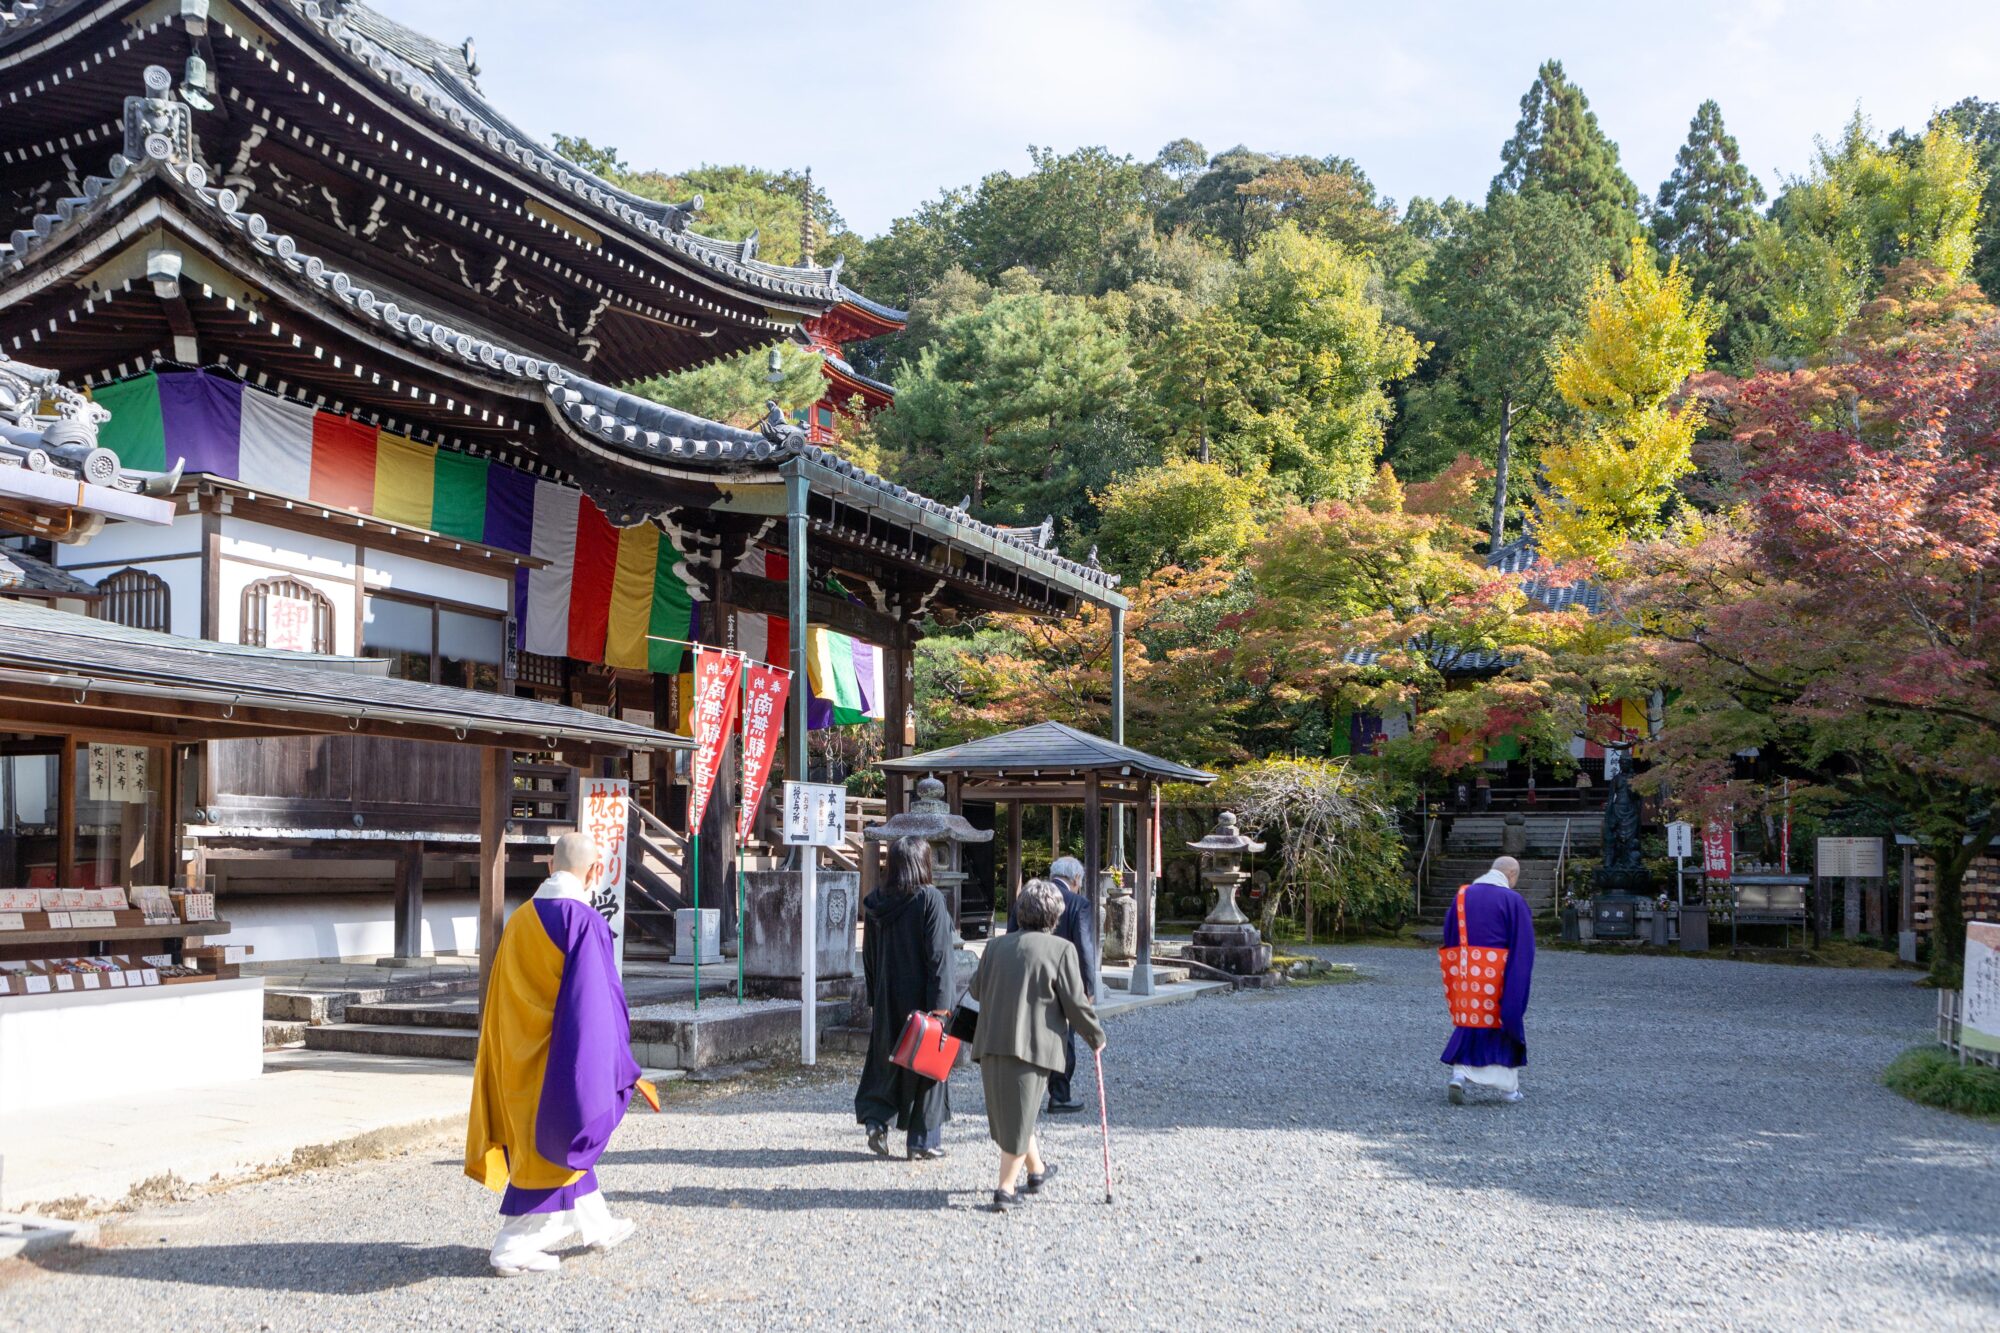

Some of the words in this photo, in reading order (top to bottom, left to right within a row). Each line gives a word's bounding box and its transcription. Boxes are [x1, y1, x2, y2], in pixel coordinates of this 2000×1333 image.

[905, 660, 914, 729] 本堂
[606, 783, 626, 886] お守り
[828, 789, 837, 827] 本堂
